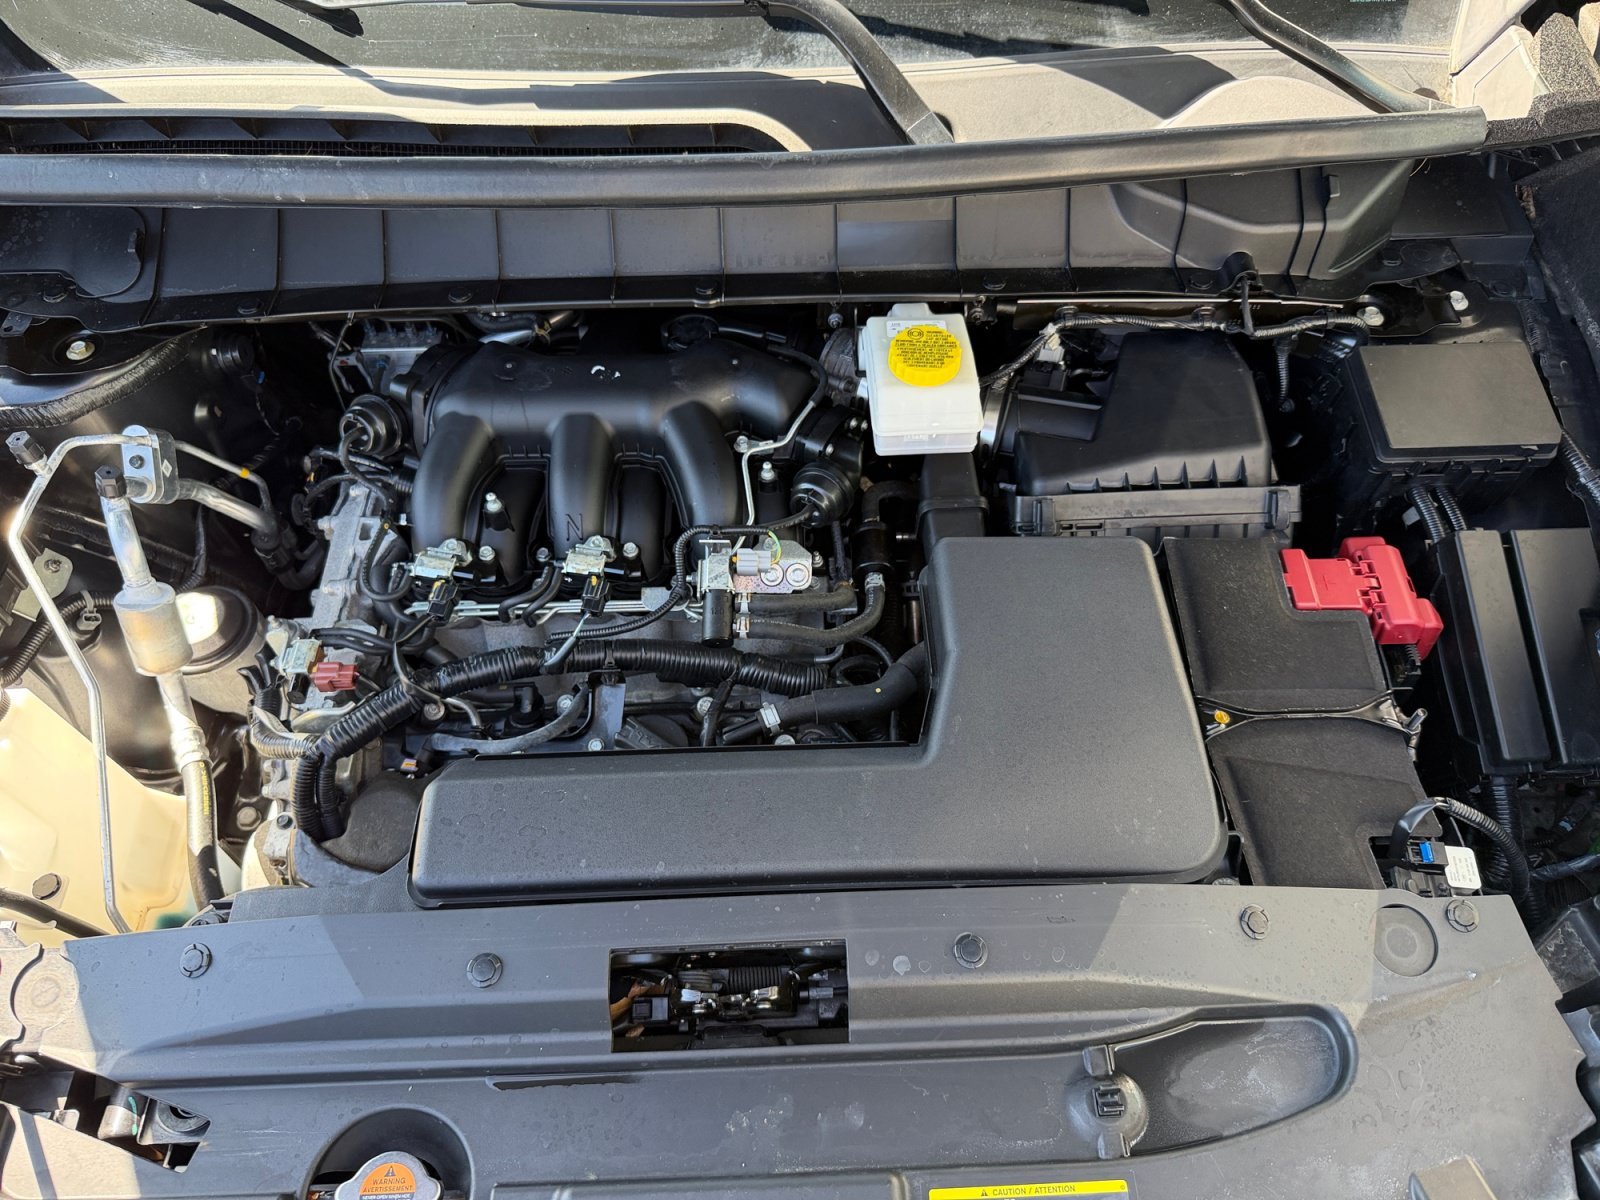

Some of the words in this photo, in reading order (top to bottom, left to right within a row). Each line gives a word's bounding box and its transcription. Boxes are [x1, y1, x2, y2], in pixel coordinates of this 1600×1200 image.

[372, 1177, 406, 1185] WARNING
[363, 1185, 413, 1193] AVERTISSEMENT
[992, 1187, 1026, 1196] CAUTION
[1034, 1185, 1076, 1194] ATTENTION
